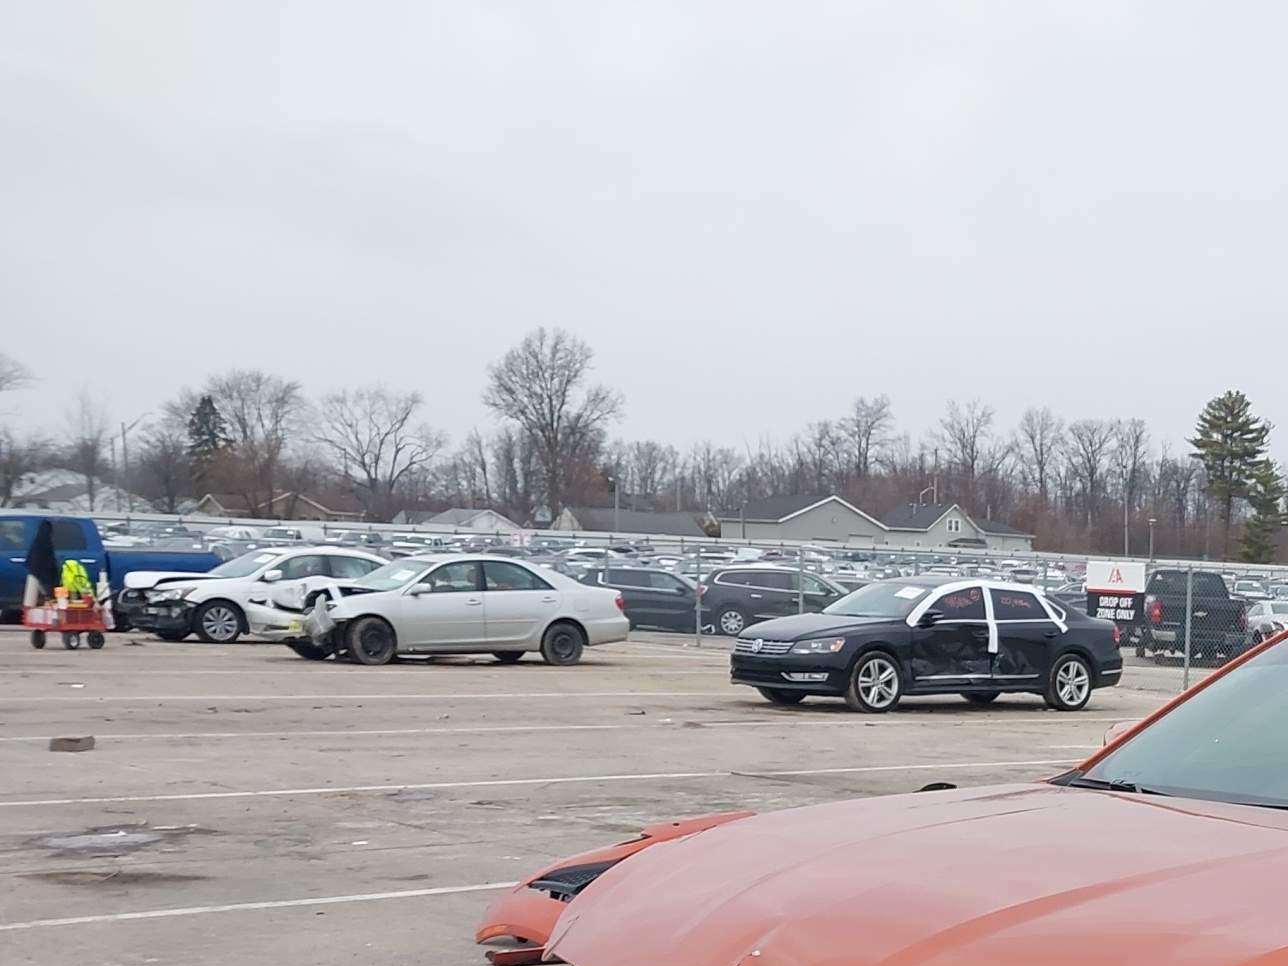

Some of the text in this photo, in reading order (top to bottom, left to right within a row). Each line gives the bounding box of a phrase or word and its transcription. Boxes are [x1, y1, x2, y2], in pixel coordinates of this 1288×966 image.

[1099, 596, 1133, 608] DROP OFF
[1096, 607, 1136, 620] ZONE ONLY
